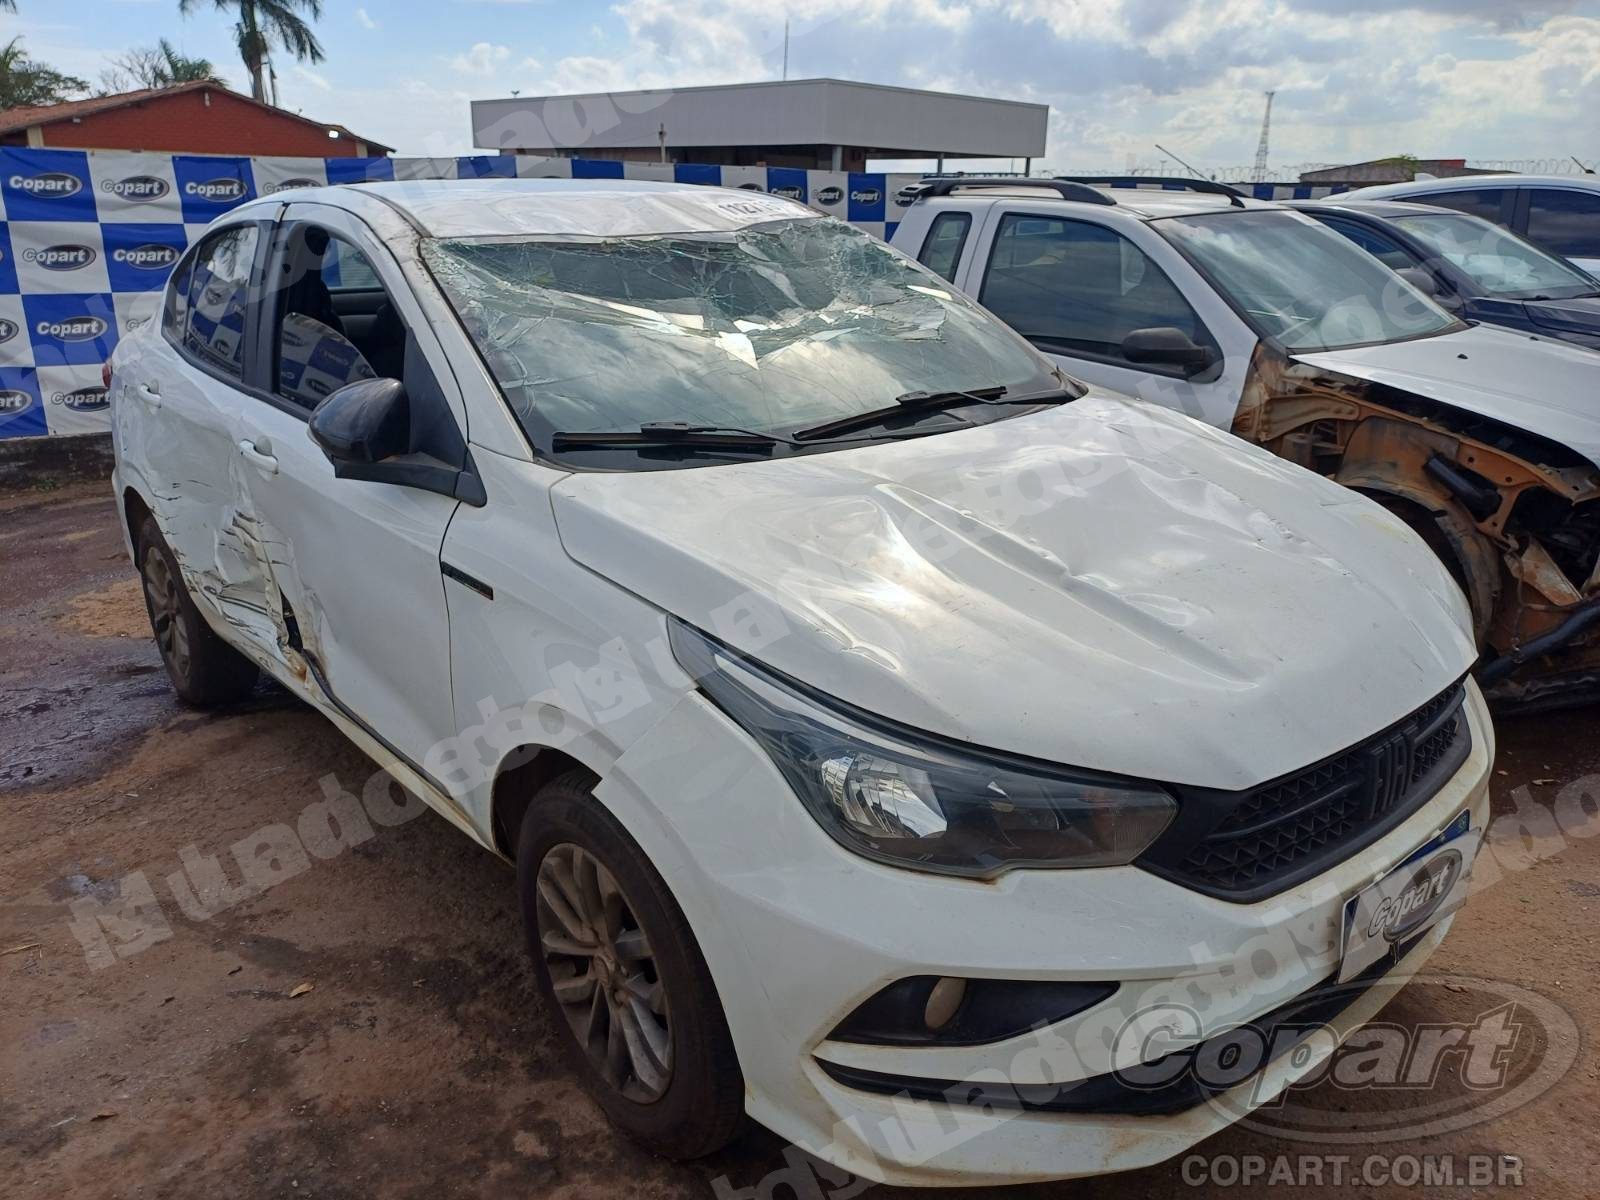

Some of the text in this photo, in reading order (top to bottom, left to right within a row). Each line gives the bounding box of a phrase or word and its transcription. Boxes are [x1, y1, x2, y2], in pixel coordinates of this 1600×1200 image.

[9, 175, 74, 193] Copart
[101, 179, 160, 196] Copart
[186, 181, 240, 196] Copart
[813, 188, 840, 201] Copart
[851, 190, 879, 203] Copart
[23, 247, 86, 263] Copart
[113, 248, 172, 264] Copart
[37, 320, 99, 337] Copart
[51, 391, 110, 407] Copart
[1368, 860, 1450, 938] Copart
